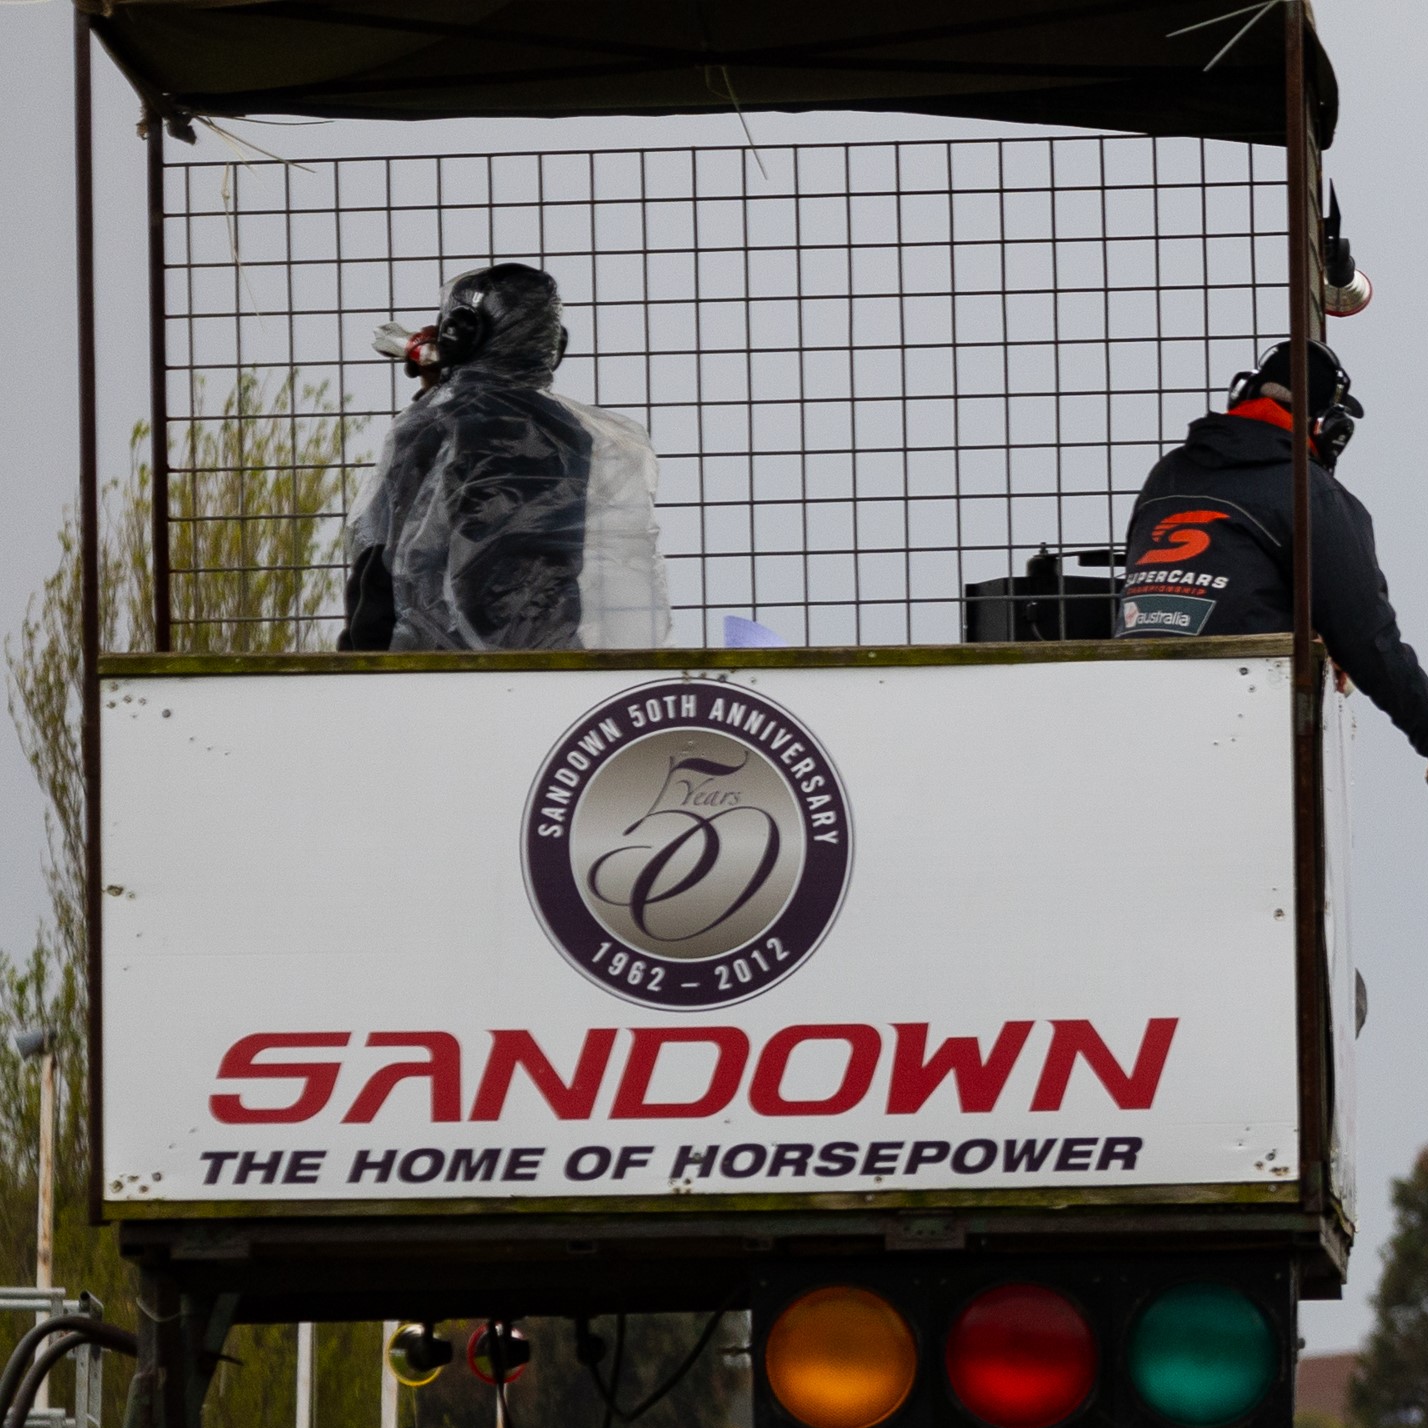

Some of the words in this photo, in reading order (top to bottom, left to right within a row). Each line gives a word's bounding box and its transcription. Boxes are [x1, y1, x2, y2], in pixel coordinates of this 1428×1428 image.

[1126, 570, 1229, 589] SUPERCARS
[1137, 610, 1190, 627] australia
[537, 718, 622, 838] SANDOWN
[628, 694, 697, 728] 50TH
[708, 698, 838, 845] ANNIVERSARY
[677, 778, 741, 806] Years
[591, 941, 666, 991] 1962
[714, 937, 790, 990] 2012
[208, 1018, 1179, 1125] SANDOWN
[199, 1150, 327, 1185] THE
[346, 1147, 546, 1184] HOME
[563, 1146, 655, 1181] OF
[670, 1136, 1144, 1179] HORSEPOWER
